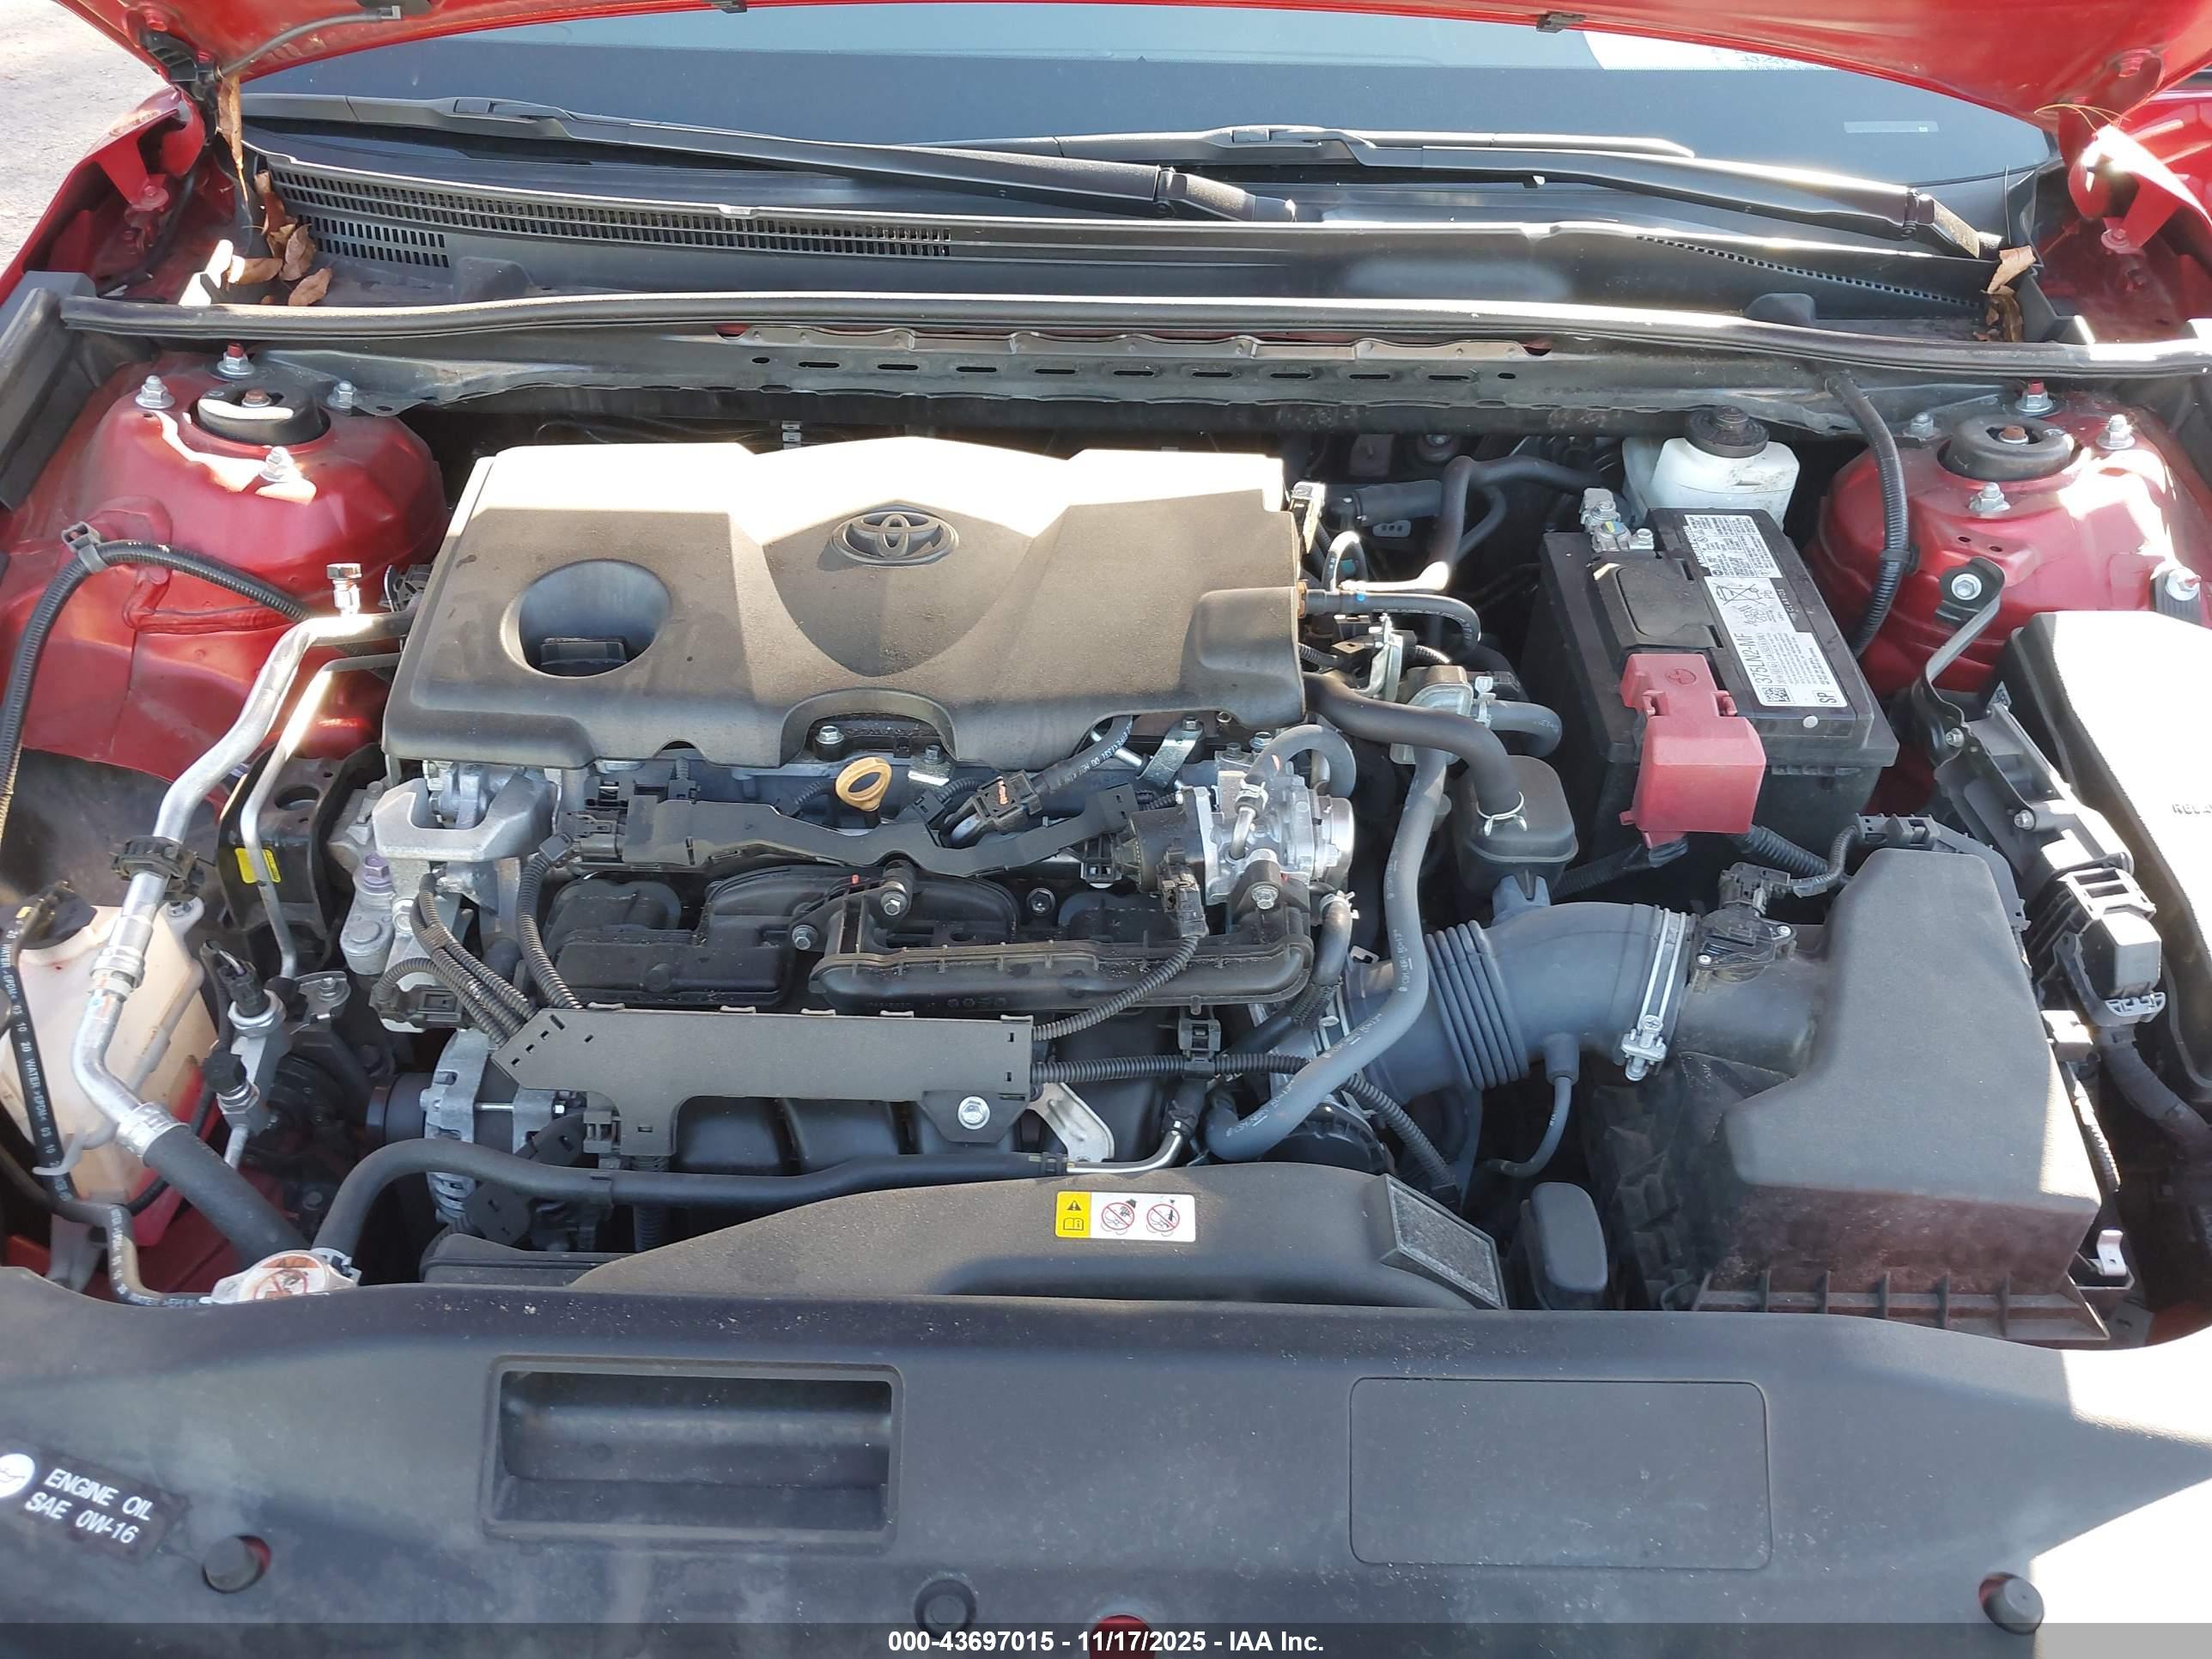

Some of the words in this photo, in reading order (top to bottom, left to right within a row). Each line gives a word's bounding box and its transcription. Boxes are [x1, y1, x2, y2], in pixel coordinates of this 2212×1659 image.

[1777, 588, 1794, 612] CLARIOS
[1734, 633, 1772, 684] 375LN2-MF
[1816, 692, 1838, 703] SP
[7, 930, 18, 939] 20
[0, 944, 11, 969] WATER
[17, 1023, 28, 1032] 10
[21, 1042, 33, 1053] 20
[25, 1059, 40, 1089] WATER
[43, 1468, 119, 1507] ENGINE
[122, 1496, 155, 1522] OIL
[24, 1492, 73, 1520] SAE
[75, 1509, 140, 1544] 0W-16
